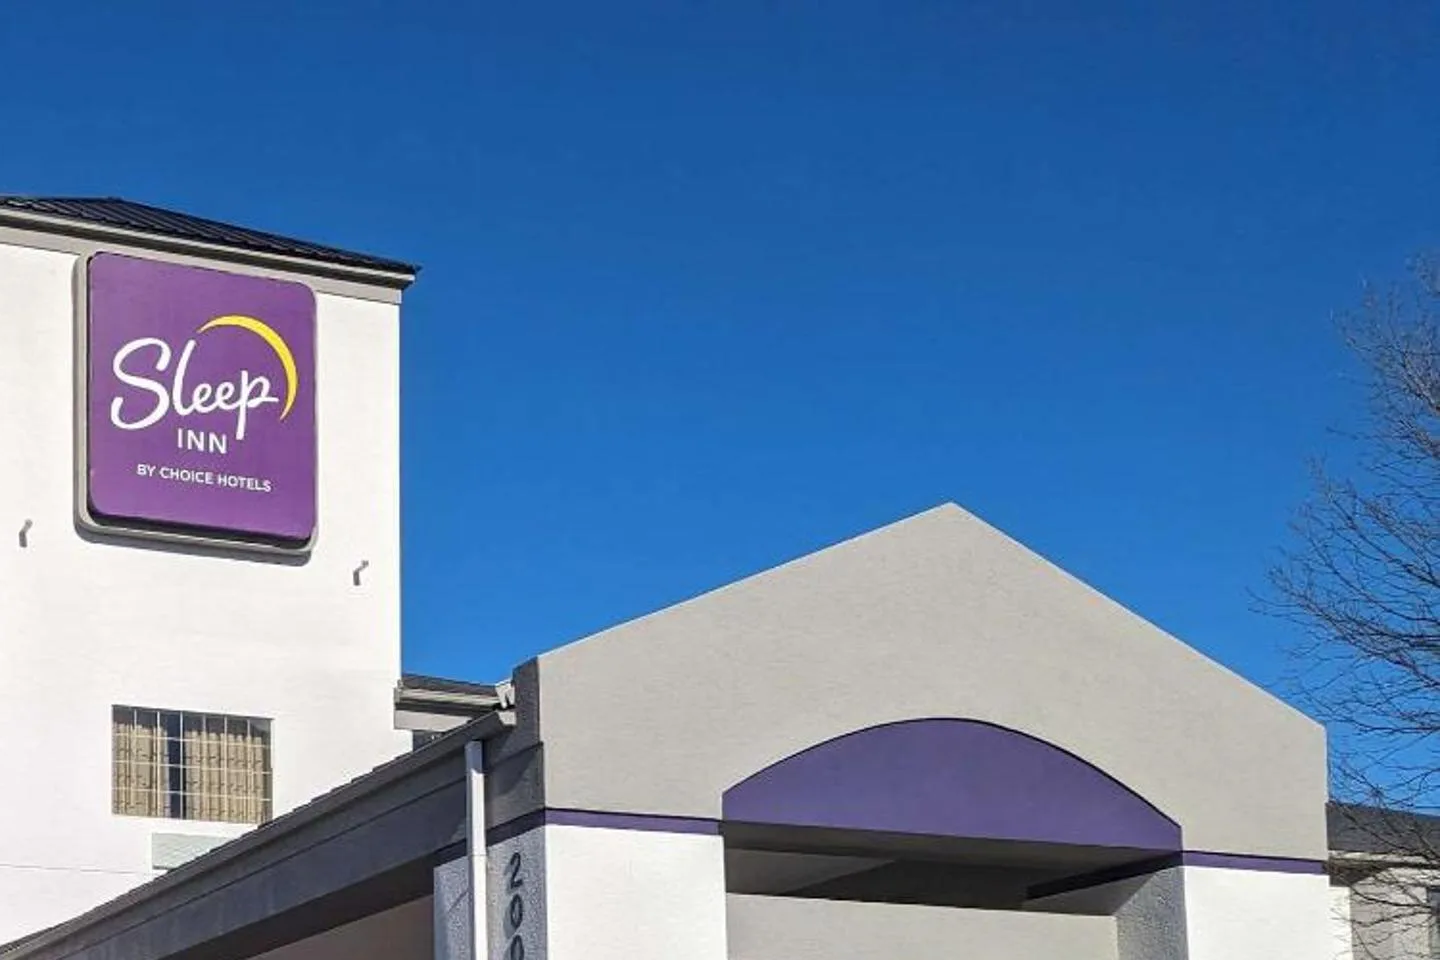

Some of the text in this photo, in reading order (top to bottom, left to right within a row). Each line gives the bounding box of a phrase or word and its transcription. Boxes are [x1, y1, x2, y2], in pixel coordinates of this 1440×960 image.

[111, 338, 279, 440] Sleep
[177, 428, 227, 454] INN
[137, 464, 272, 492] BY CHOICE HOTELS
